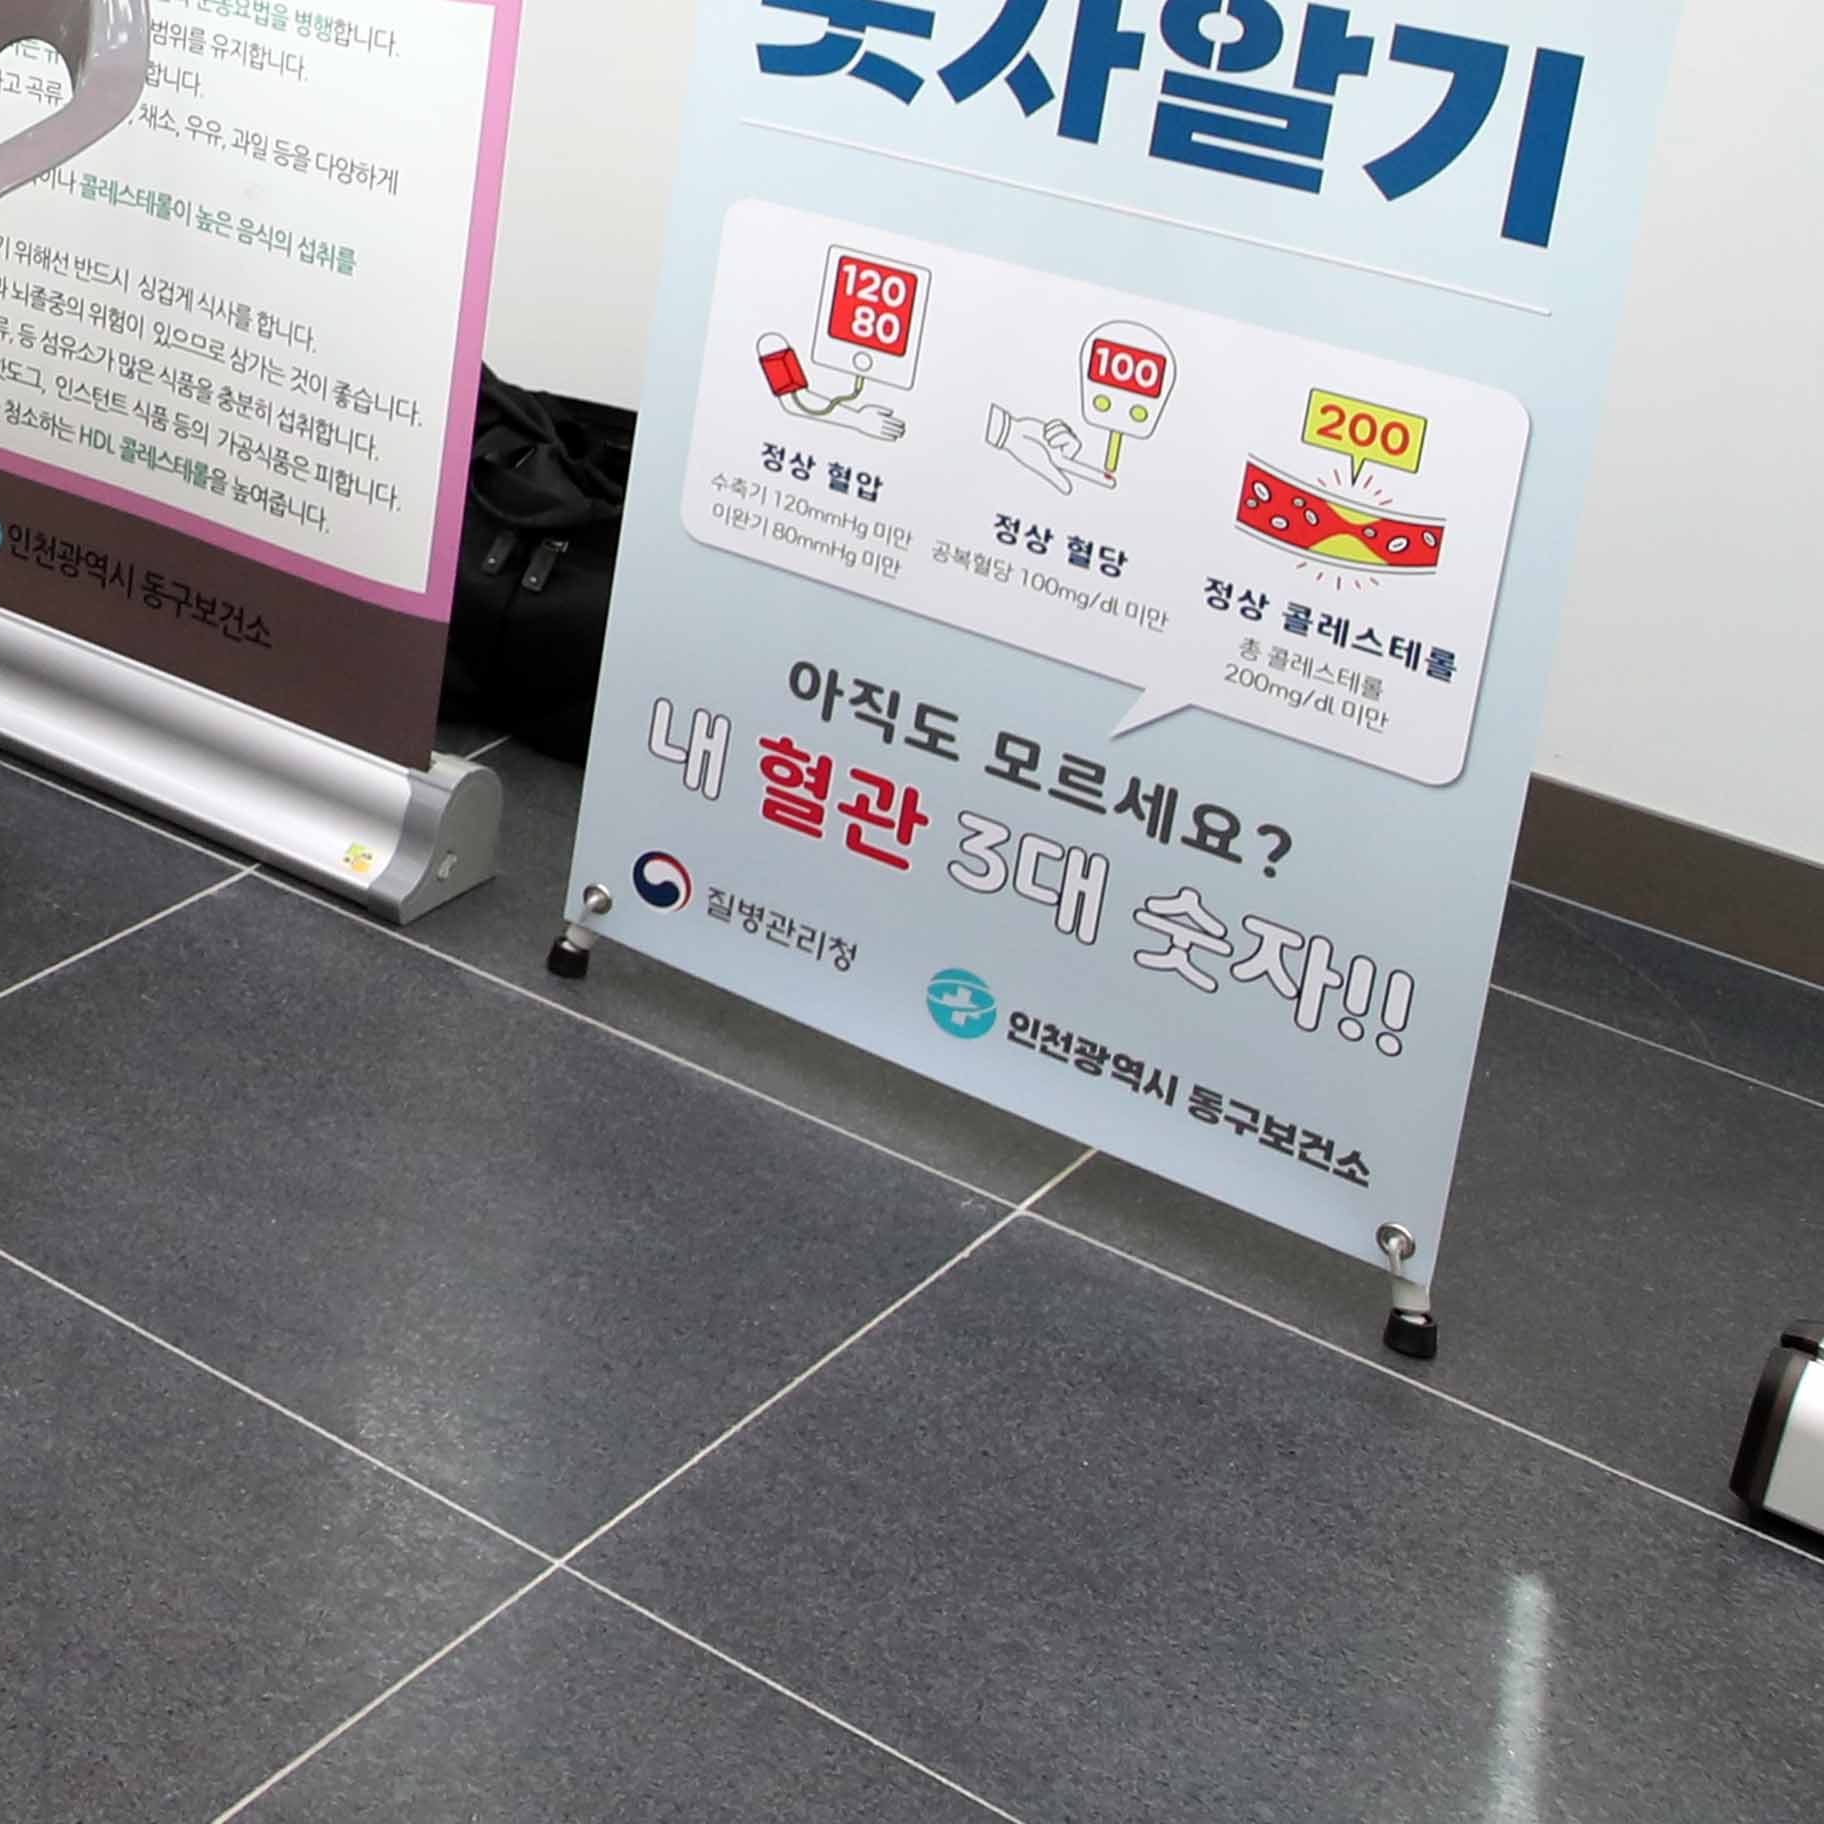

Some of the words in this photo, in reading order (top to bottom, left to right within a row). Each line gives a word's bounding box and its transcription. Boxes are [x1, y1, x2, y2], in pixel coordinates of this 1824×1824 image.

[14, 240, 69, 276] 위해선
[74, 255, 129, 293] 반드시
[138, 274, 193, 312] 싱겁게
[198, 292, 253, 332] 식사를
[257, 310, 318, 354] 합니다.
[842, 264, 907, 308] 120
[851, 306, 901, 344] 80
[1096, 346, 1158, 388] 100
[4, 399, 76, 443] 청소하는
[79, 425, 115, 454] HDL
[119, 435, 229, 496] 콜레스테롤을
[232, 476, 331, 535] 높여줍니다.
[1316, 404, 1410, 456] 200
[761, 442, 816, 483] 정상
[827, 461, 884, 503] 혈압
[711, 473, 767, 505] 수축기
[773, 490, 869, 539] 120mmHg
[873, 523, 912, 552] 미만
[712, 503, 768, 537] 이완기
[772, 523, 856, 567] 80mmHg
[862, 549, 902, 580] 미만
[993, 513, 1054, 556] 정상
[1066, 534, 1129, 579] 혈당
[7, 521, 135, 600] 인천광역시
[140, 573, 274, 650] 동구보건소
[932, 540, 1013, 583] 공복혈당
[1125, 603, 1169, 633] 미만
[1204, 577, 1271, 622] 정상
[1282, 601, 1458, 684] 콜레스테롤
[1239, 637, 1262, 661] 총
[1268, 645, 1384, 702] 콜레스테롤
[1340, 702, 1390, 734] 미만
[788, 659, 962, 763] 아직도
[984, 729, 1293, 880] 모르세요?
[648, 696, 732, 802] 내
[755, 735, 929, 871] 혈관
[948, 809, 1110, 946] 3대
[1132, 885, 1416, 1058] 숫자!!
[706, 885, 858, 972] 질병관리청
[1007, 1009, 1178, 1108] 인천광역시
[1187, 1085, 1373, 1188] 동구보건소
